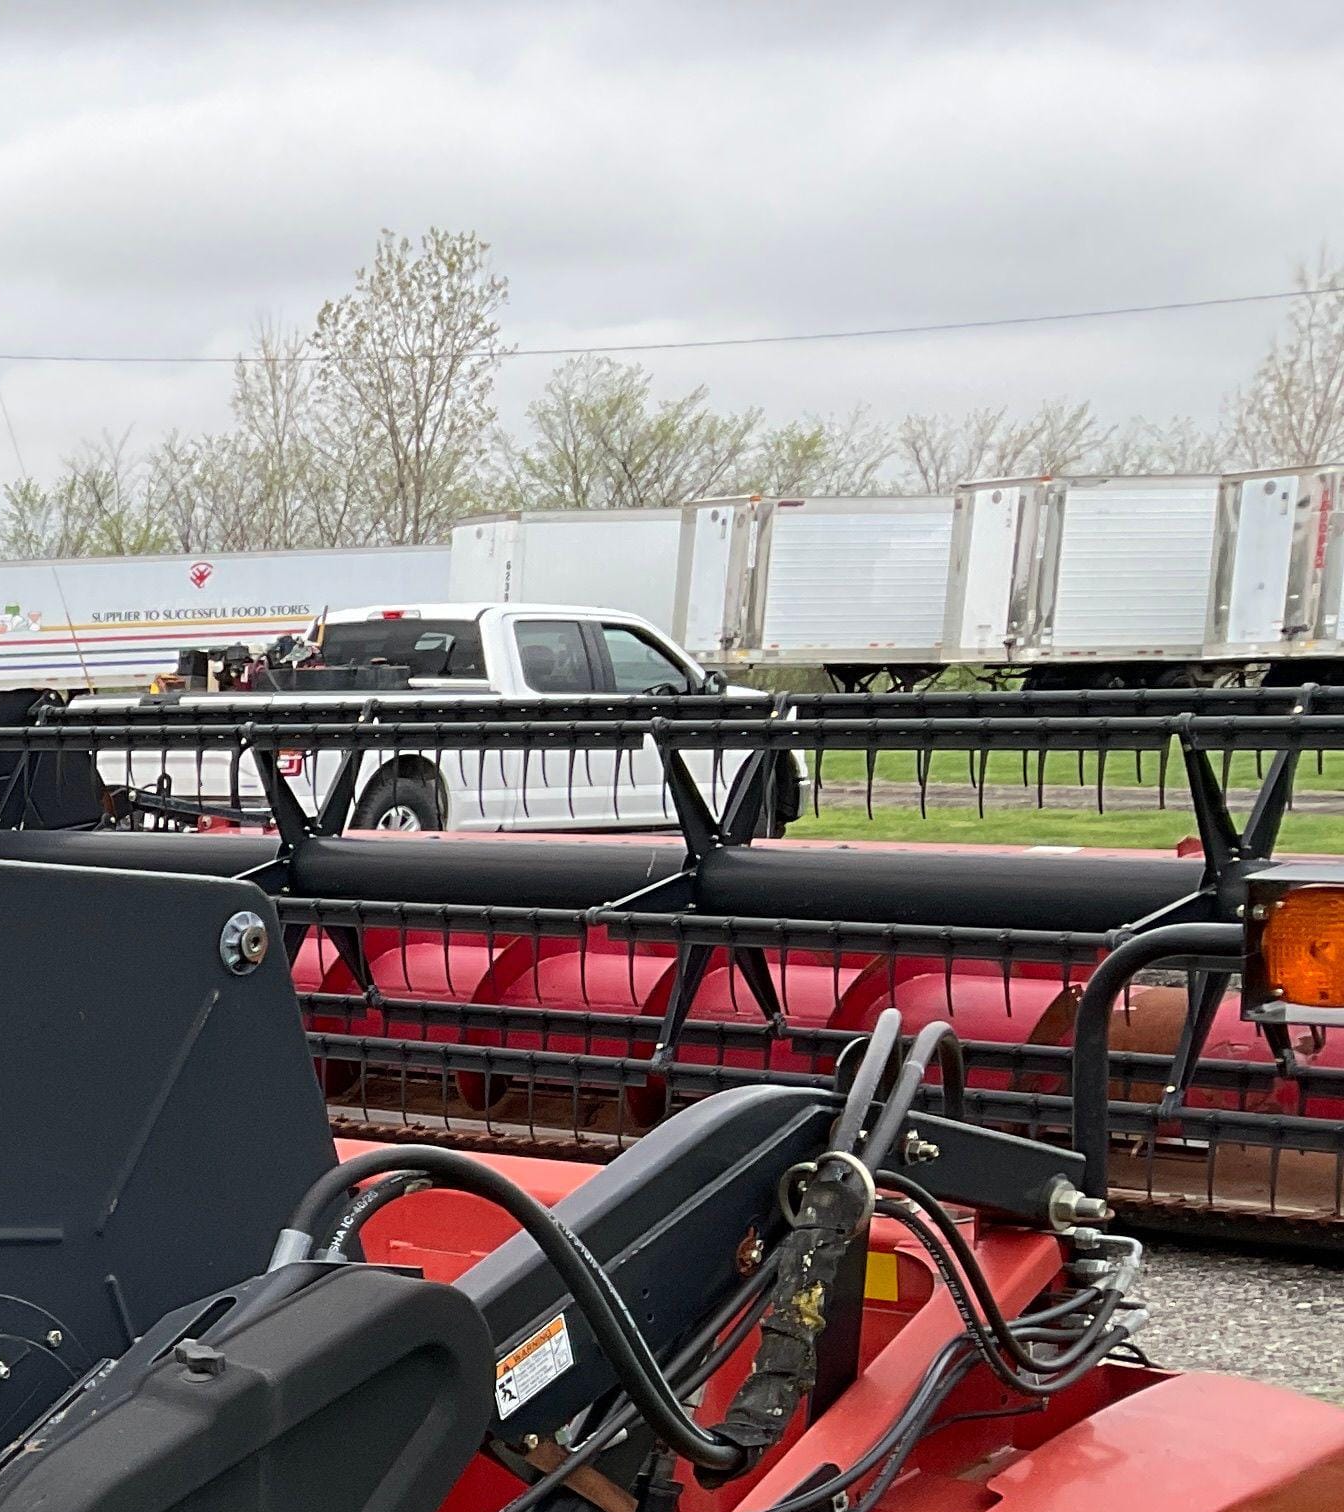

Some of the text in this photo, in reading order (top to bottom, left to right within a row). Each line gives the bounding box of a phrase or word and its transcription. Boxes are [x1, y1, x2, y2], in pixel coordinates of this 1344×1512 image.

[91, 604, 310, 623] SUPPLIER TO SUCCESSFUL FOOD STORES
[513, 1328, 553, 1363] WARNING
